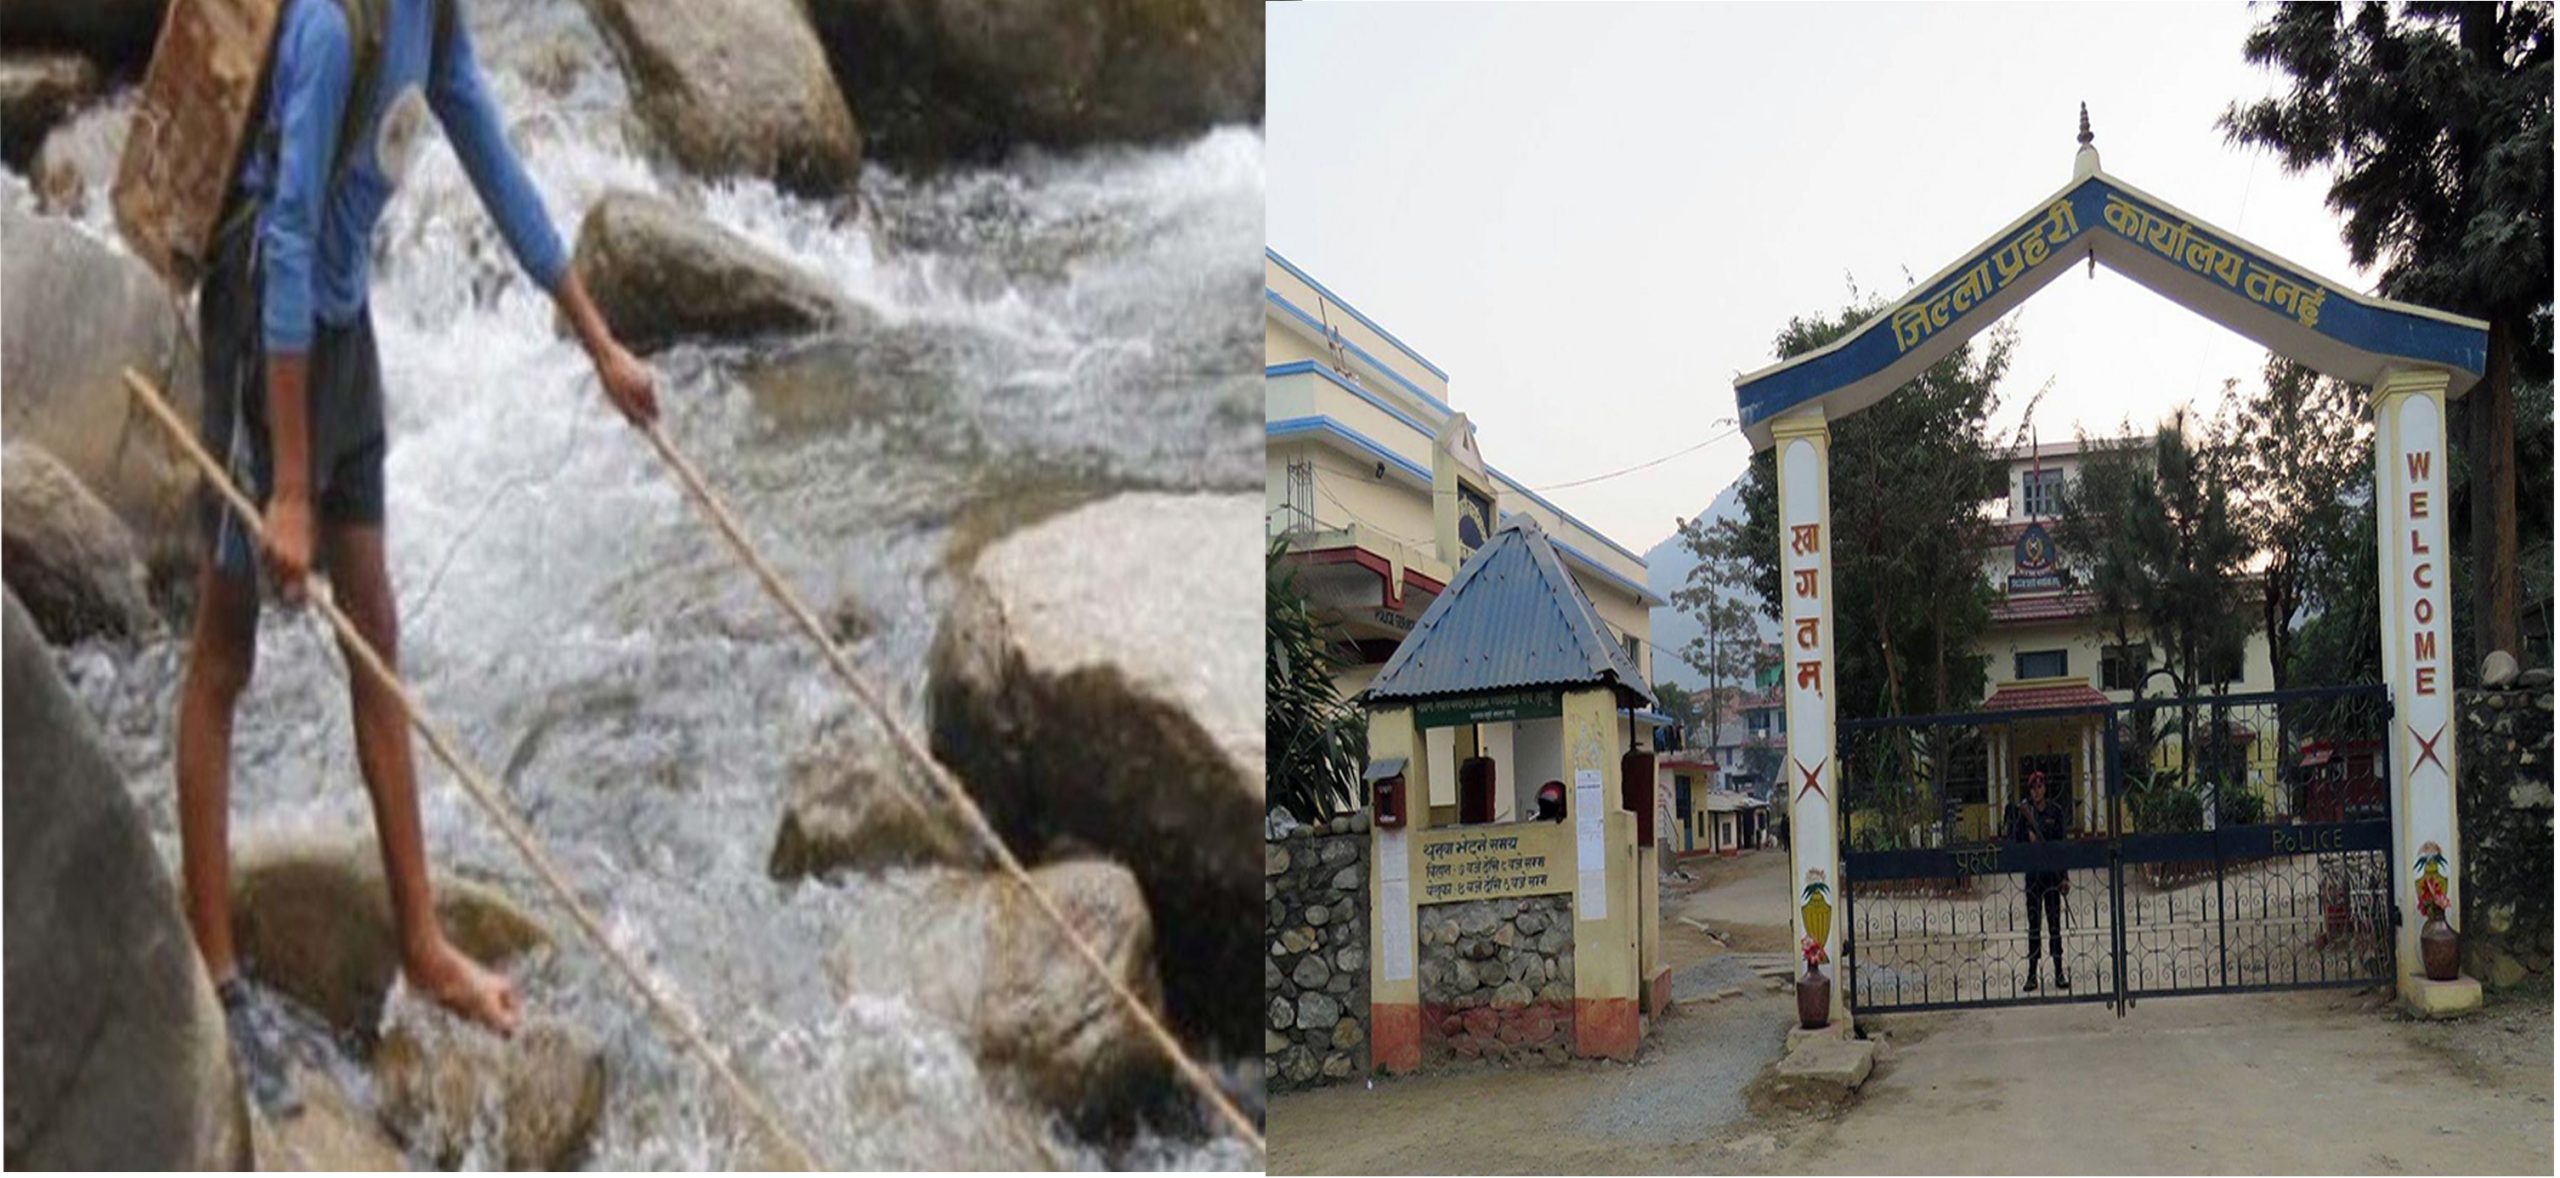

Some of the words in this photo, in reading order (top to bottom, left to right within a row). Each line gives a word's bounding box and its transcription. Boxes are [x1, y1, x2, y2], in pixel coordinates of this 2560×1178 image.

[1892, 259, 1993, 352] जिल्ला
[1992, 199, 2079, 288] प्रहरी
[2103, 193, 2244, 288] कार्यालय
[2406, 451, 2436, 696] WELCOME
[1490, 836, 1518, 851] समय
